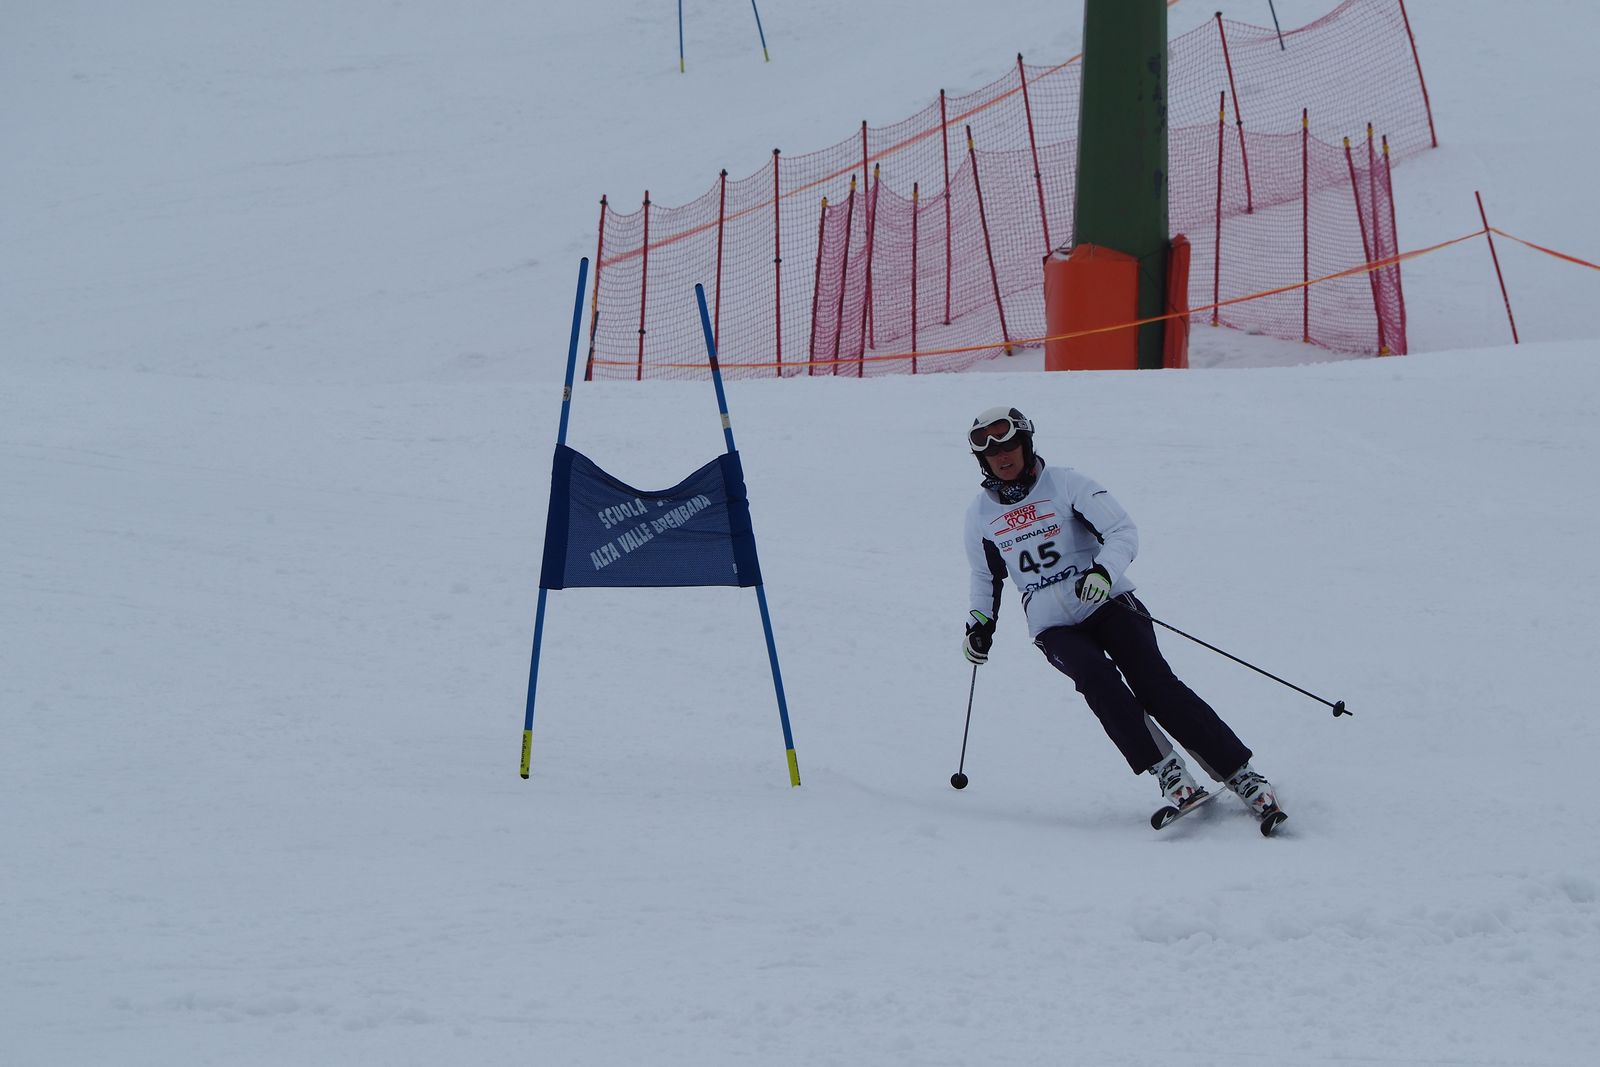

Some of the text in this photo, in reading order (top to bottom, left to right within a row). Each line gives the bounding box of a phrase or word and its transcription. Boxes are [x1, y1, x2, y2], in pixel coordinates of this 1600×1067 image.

[598, 498, 648, 529] SCUOLA
[1004, 504, 1035, 520] PERICO
[1007, 509, 1037, 528] SPORT
[590, 494, 711, 570] ALTA VALLE BREMBANA
[1015, 524, 1058, 543] BONALDI
[1019, 541, 1061, 574] 45
